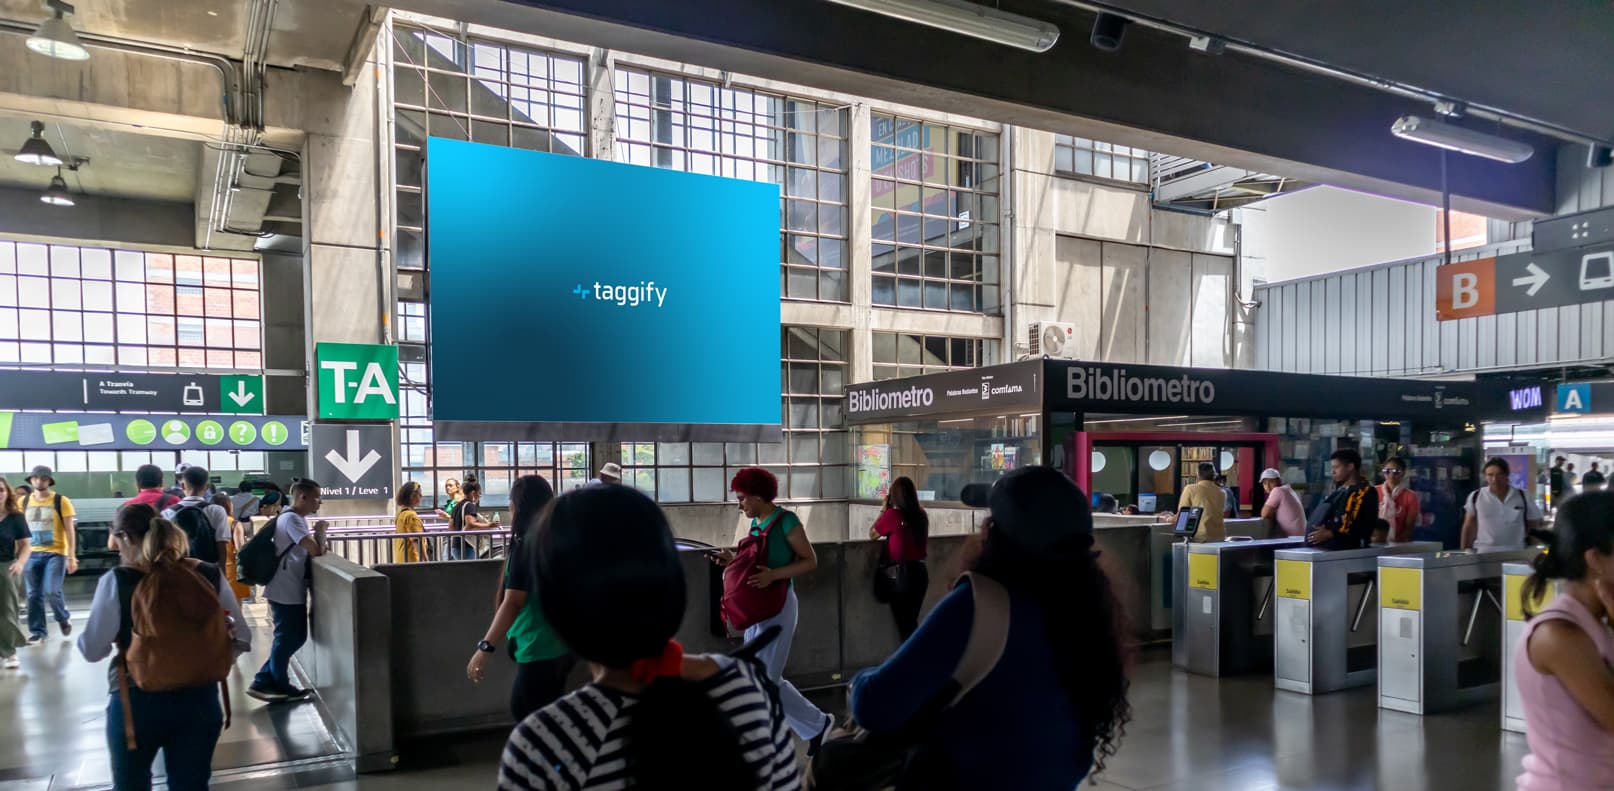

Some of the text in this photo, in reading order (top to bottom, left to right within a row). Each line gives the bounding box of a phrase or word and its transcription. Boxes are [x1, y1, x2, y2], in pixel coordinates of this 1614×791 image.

[593, 281, 668, 308] taggify
[1452, 272, 1479, 310] B
[321, 361, 397, 405] T-A
[991, 384, 1023, 395] comfama
[1066, 366, 1215, 404] Bibliometro
[849, 385, 934, 413] Bibliometro
[1510, 386, 1542, 410] WOM
[1564, 389, 1583, 410] A
[320, 486, 342, 495] Nivel
[345, 486, 350, 495] 1
[358, 487, 378, 495] Leve
[383, 486, 388, 495] 1
